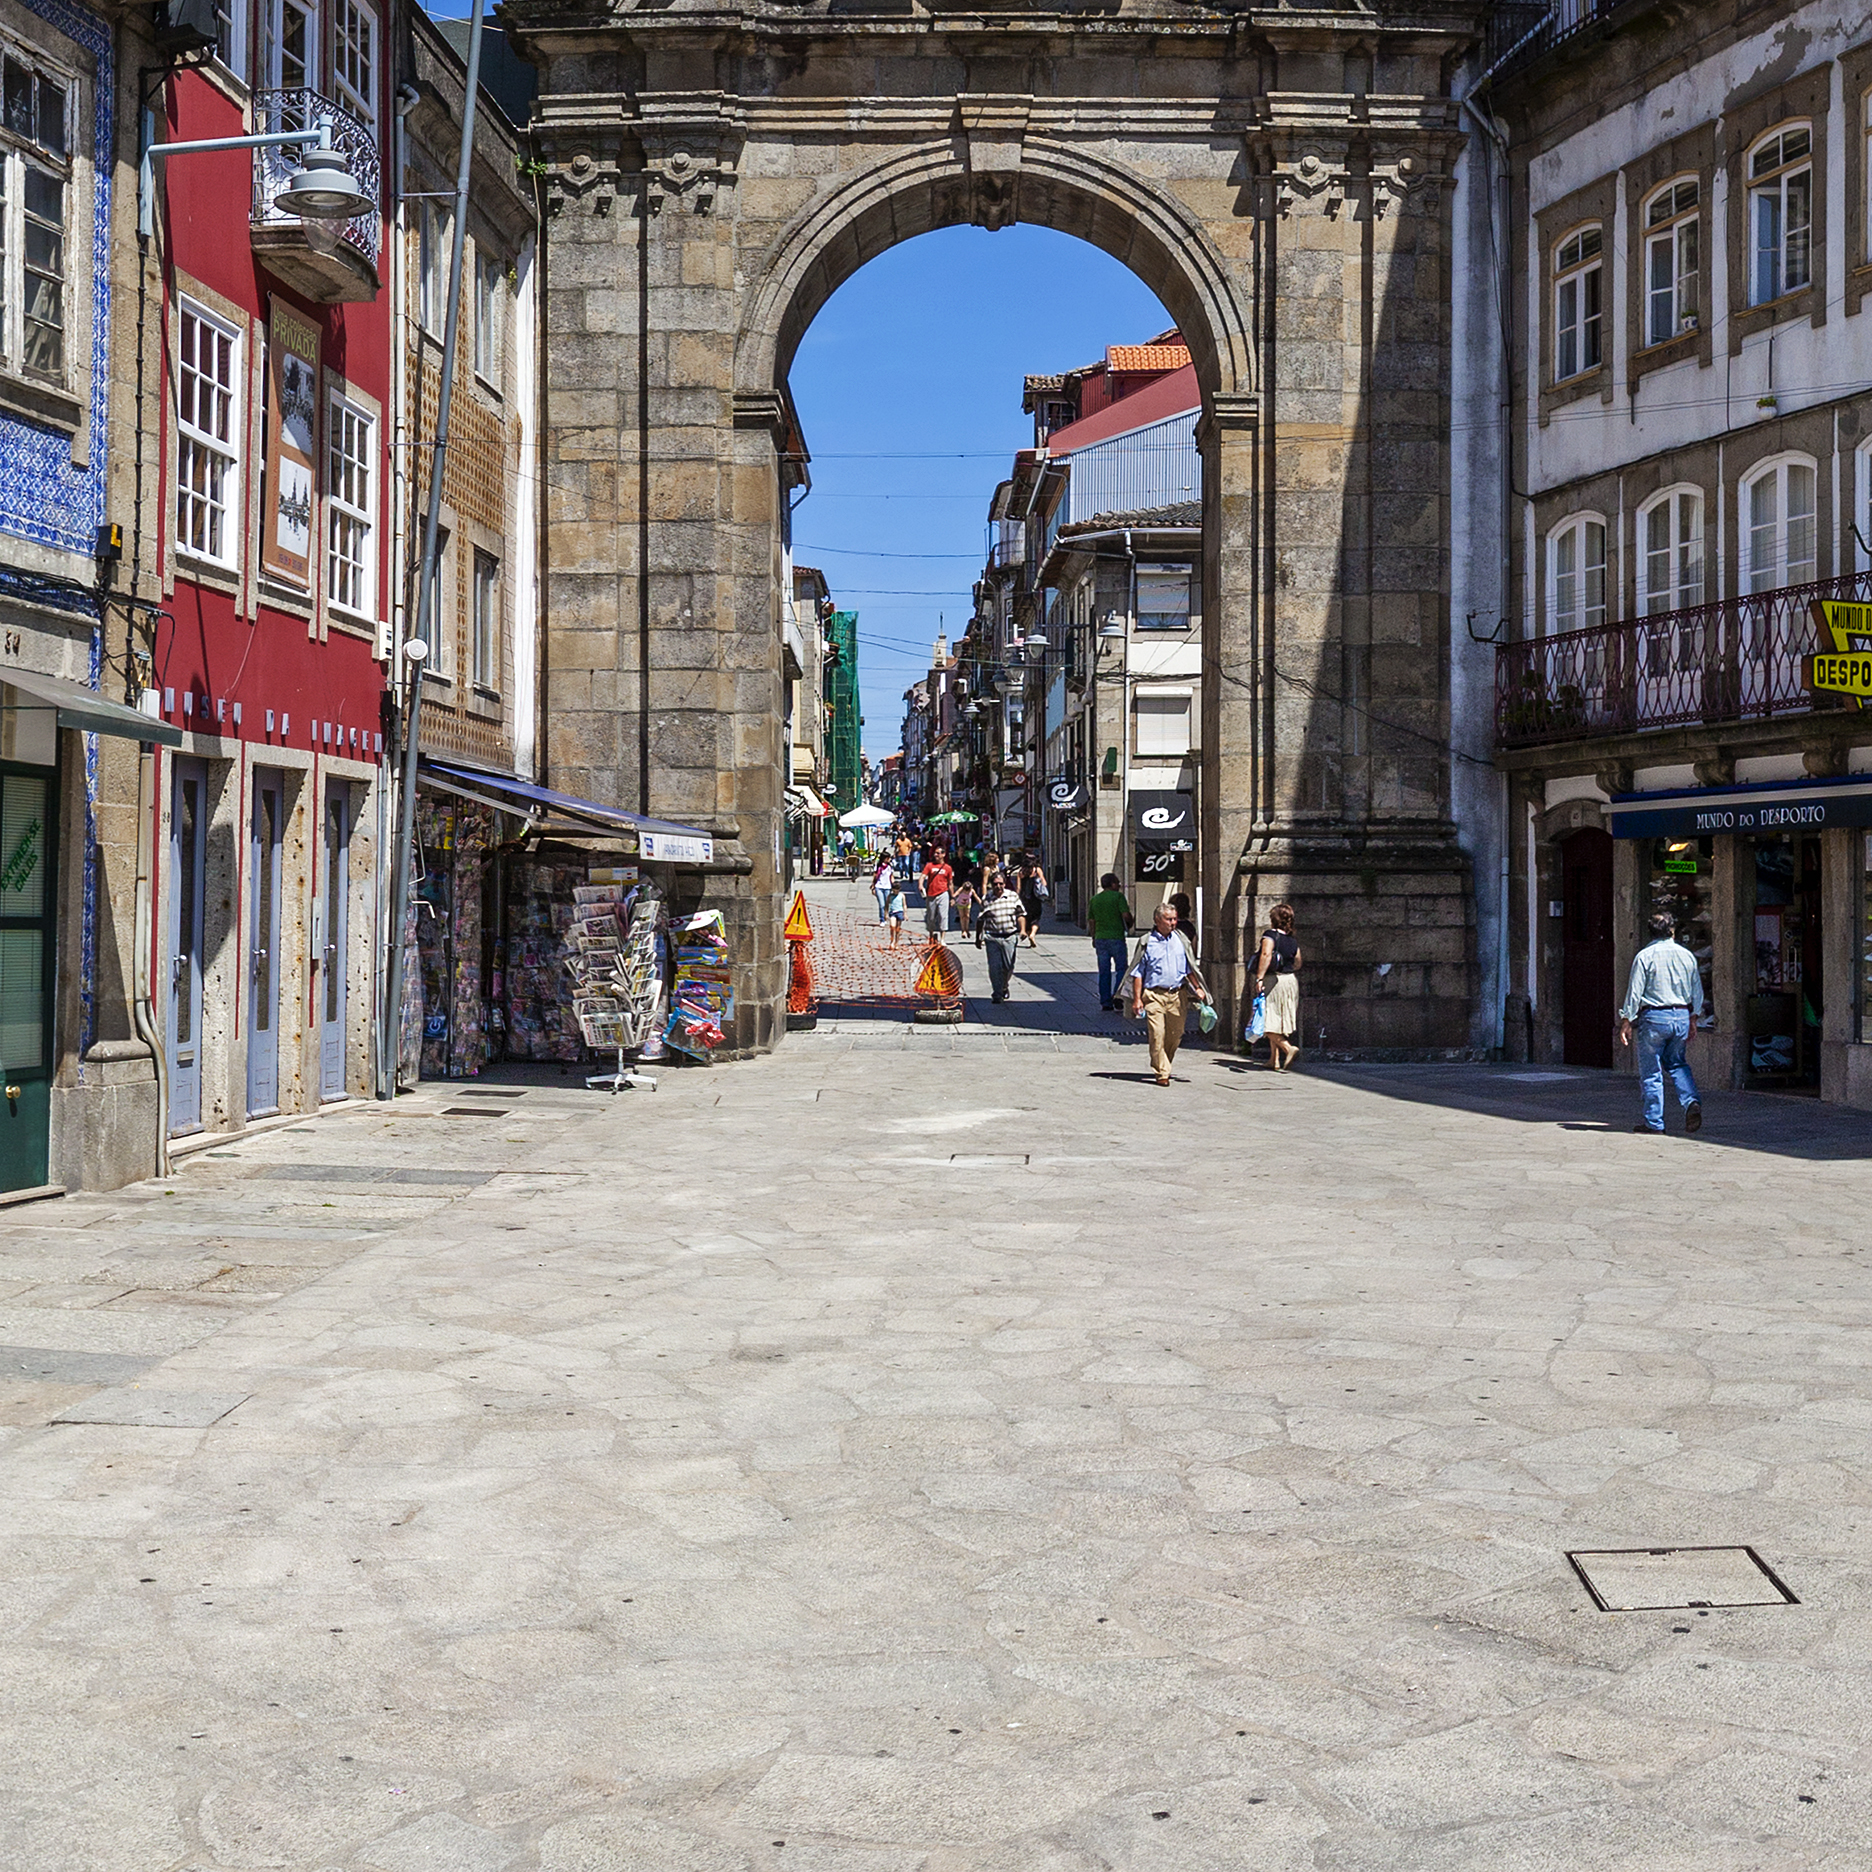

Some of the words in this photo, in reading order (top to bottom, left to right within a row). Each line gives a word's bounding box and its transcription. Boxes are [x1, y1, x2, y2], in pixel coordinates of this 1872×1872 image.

[273, 318, 317, 364] PRIVADA
[1831, 604, 1863, 631] MUNDO
[1696, 811, 1735, 830] MUNDO
[1739, 813, 1755, 827] DO
[1760, 804, 1826, 826] DESPORTO
